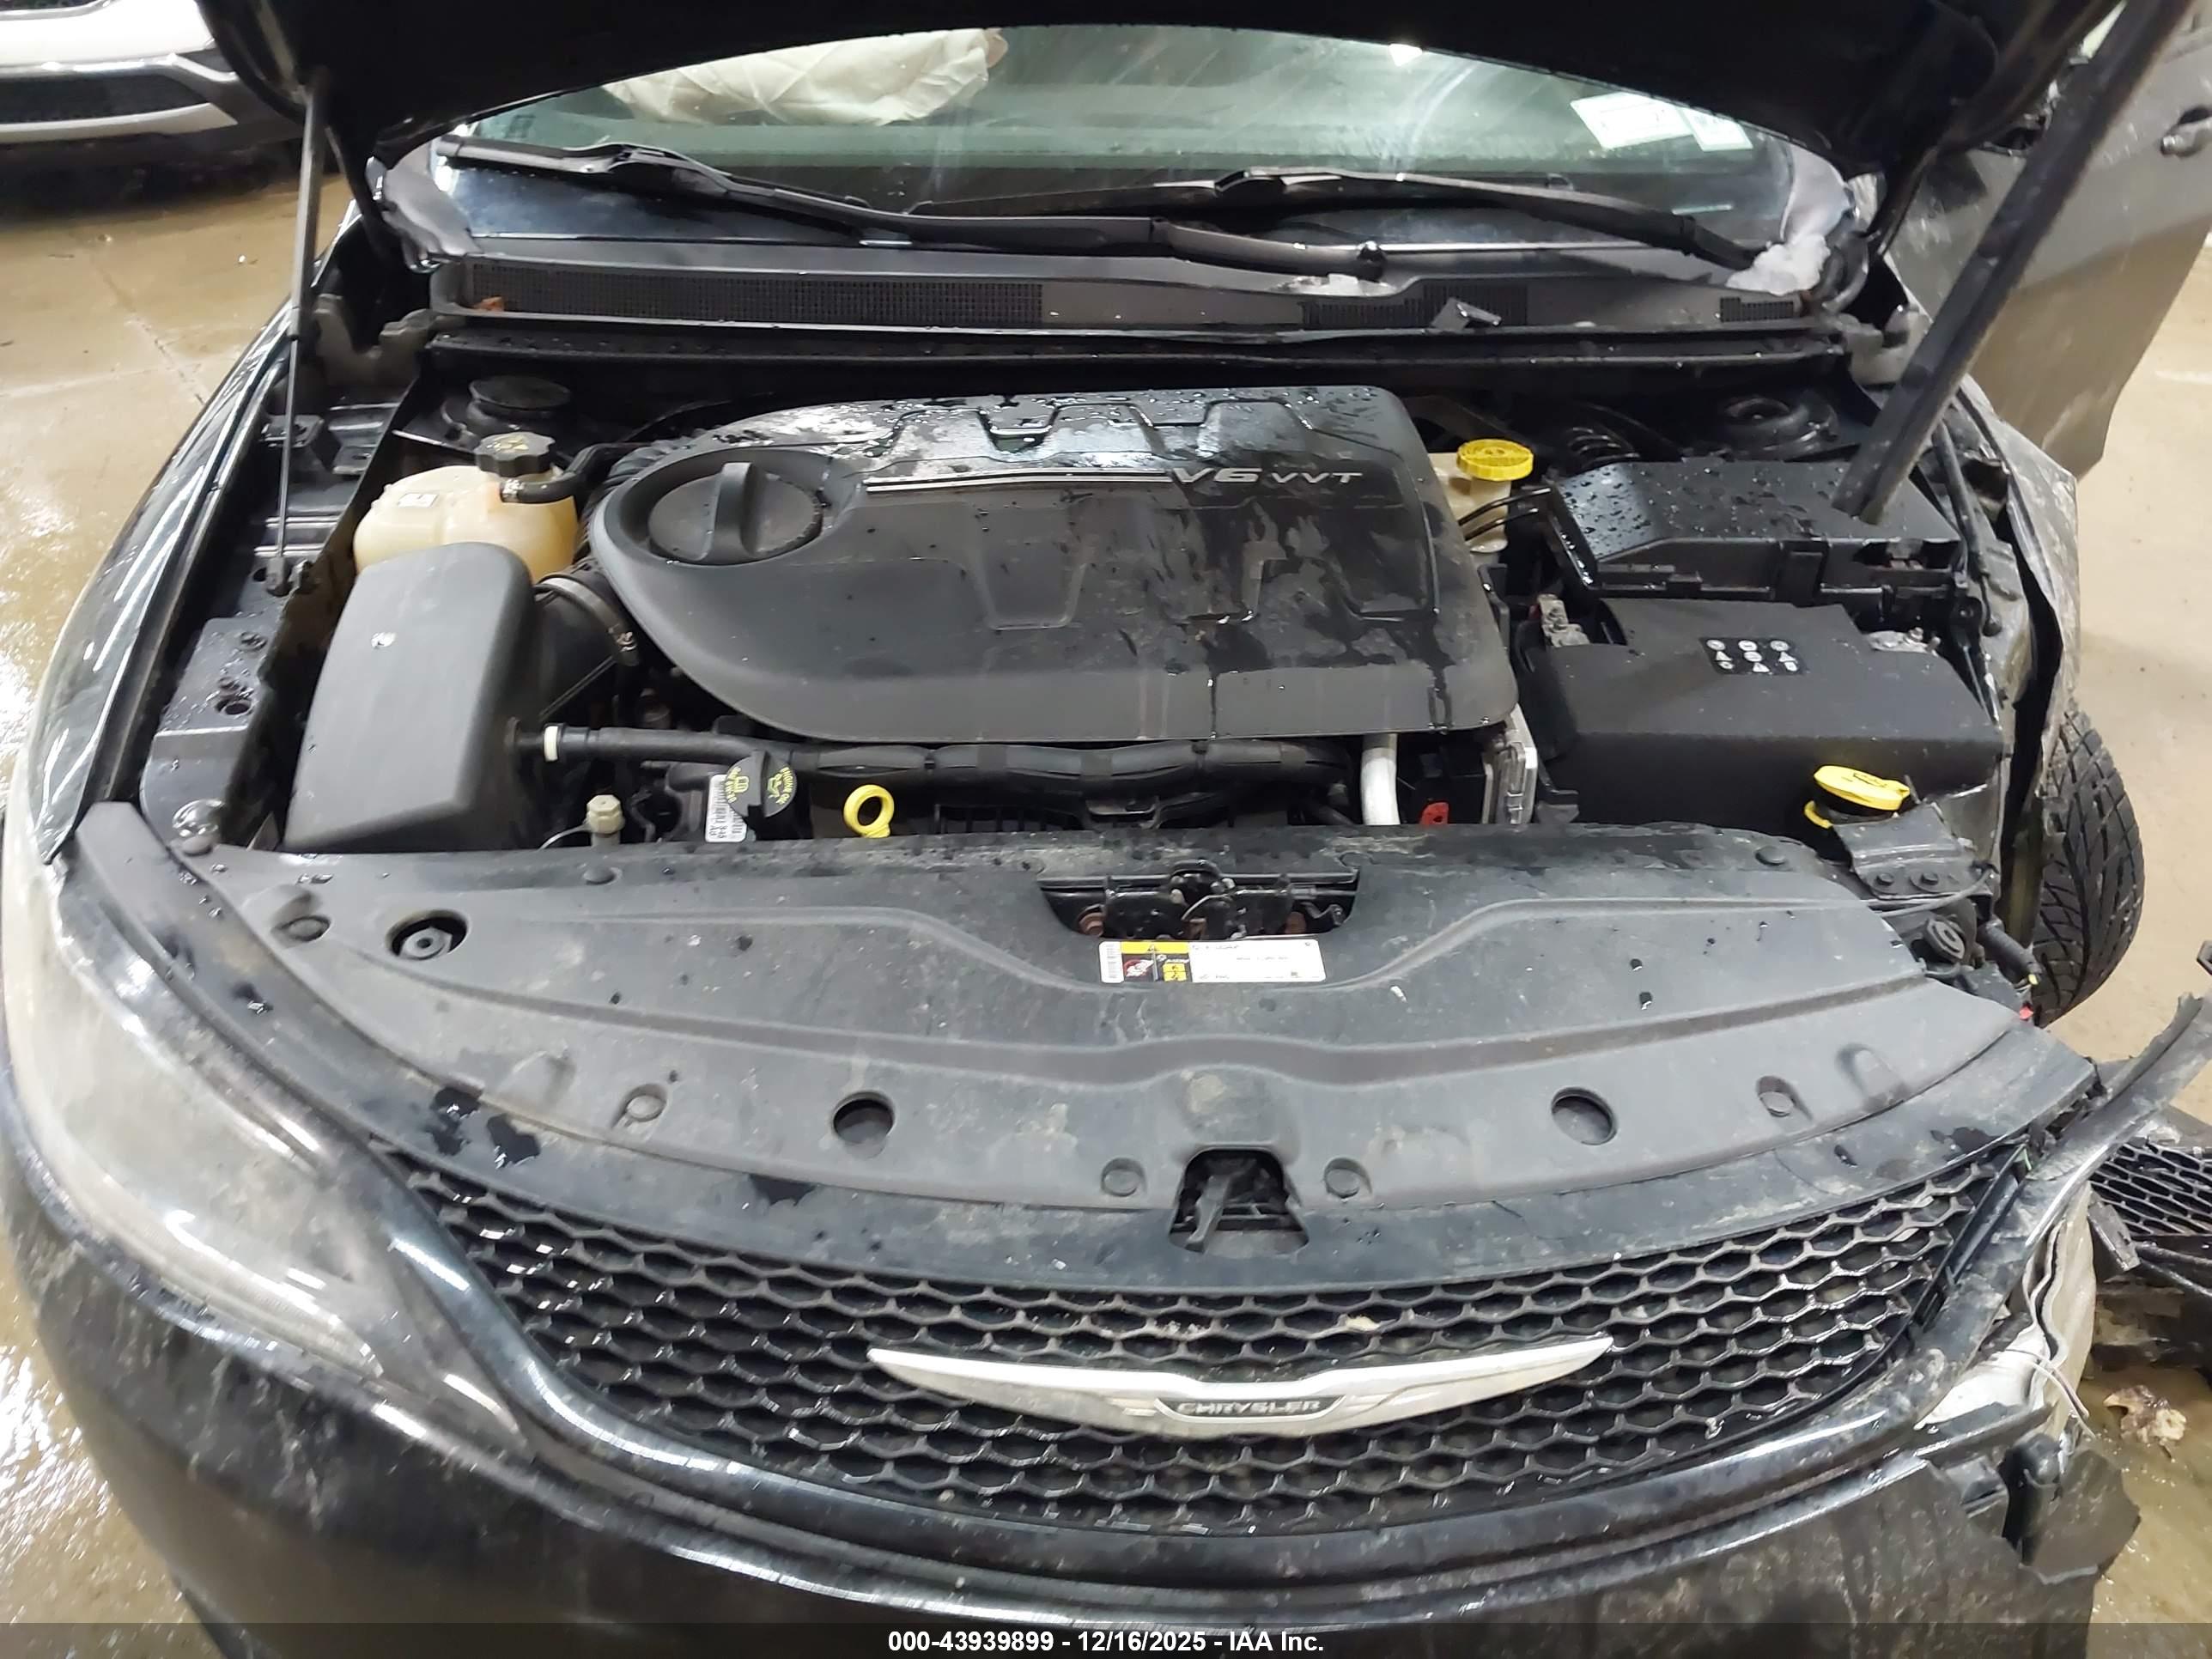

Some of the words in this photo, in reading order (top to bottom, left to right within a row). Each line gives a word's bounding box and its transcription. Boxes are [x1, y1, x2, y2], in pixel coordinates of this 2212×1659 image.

[1173, 467, 1263, 483] V6
[1272, 471, 1364, 484] VVT
[780, 766, 793, 793] ENGINE
[775, 793, 790, 805] OIL
[1176, 1401, 1321, 1416] CHRYSLER
